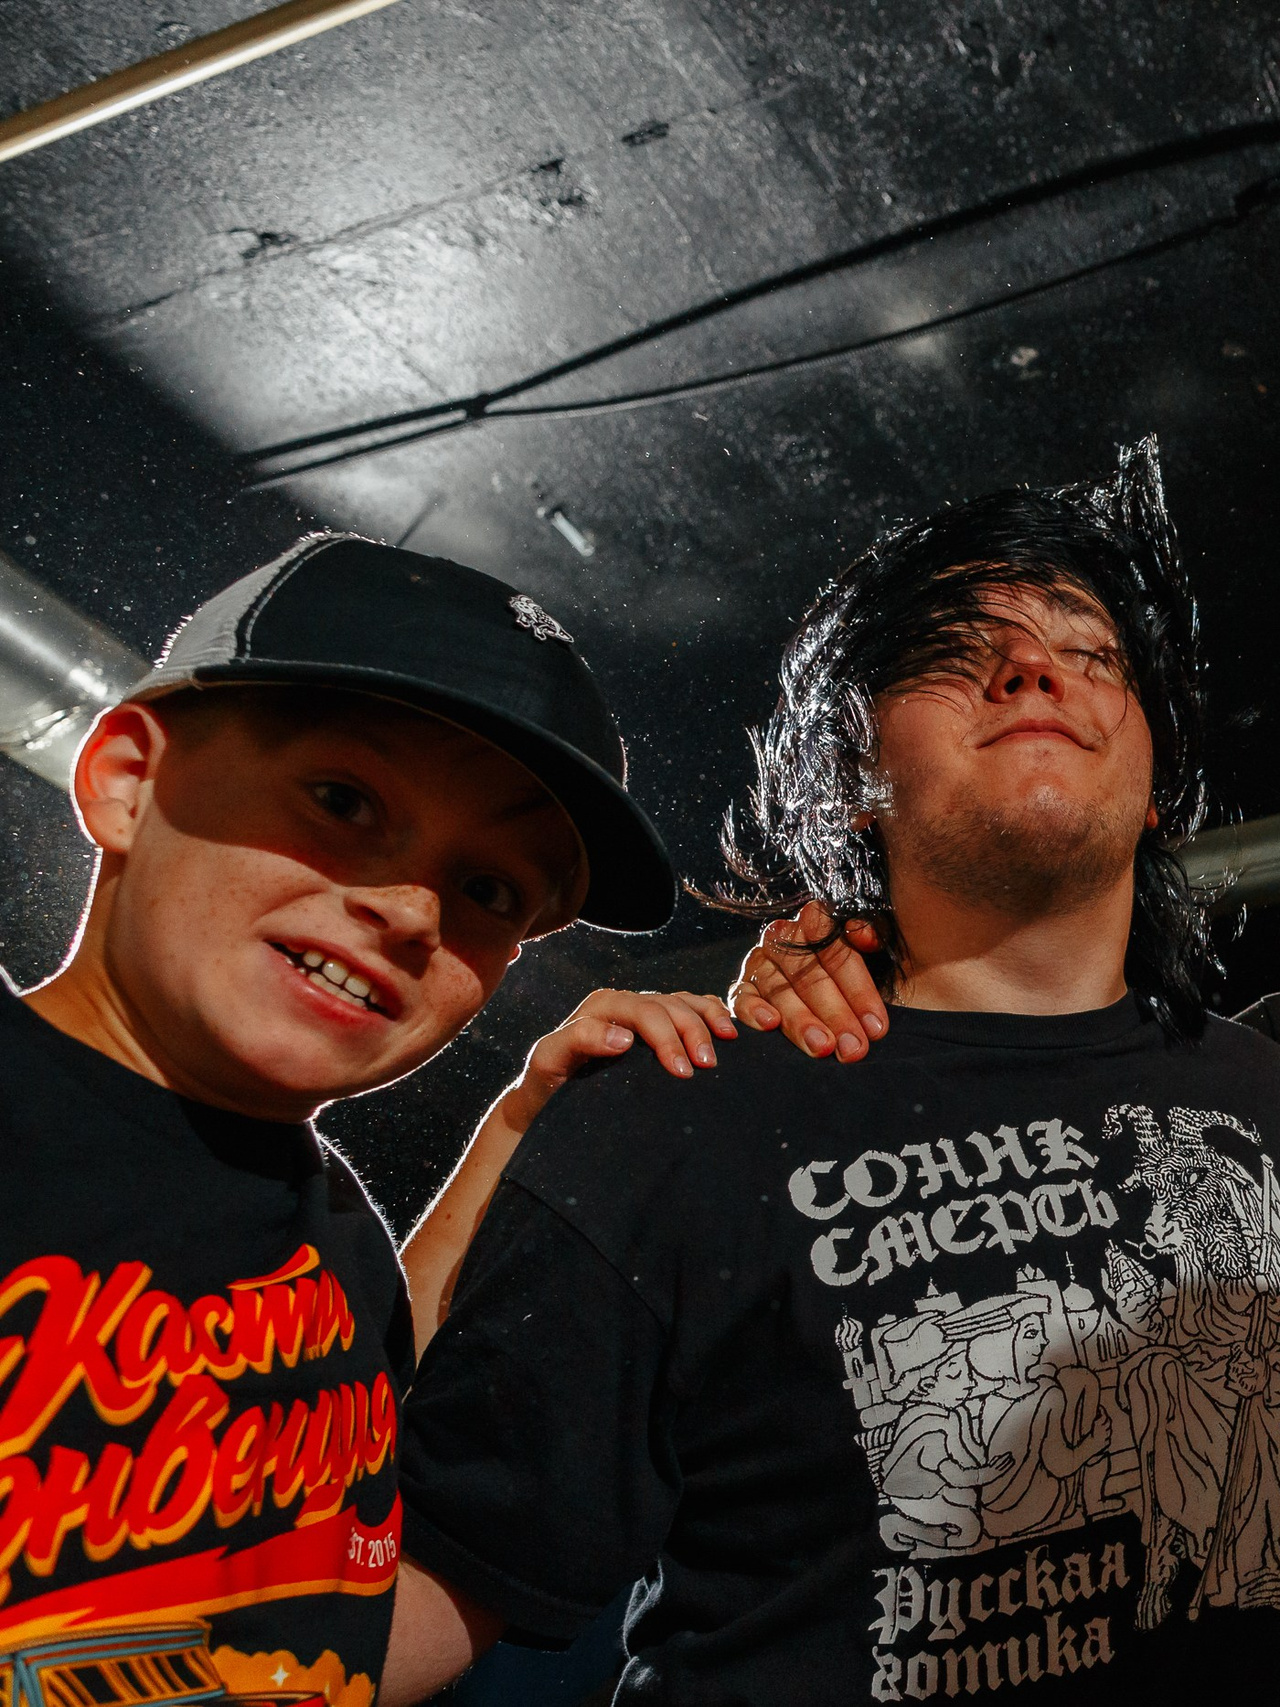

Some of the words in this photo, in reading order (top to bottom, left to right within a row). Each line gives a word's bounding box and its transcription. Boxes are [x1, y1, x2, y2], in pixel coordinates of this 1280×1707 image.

[788, 1118, 1099, 1220] СОНИК
[811, 1179, 1119, 1286] СМЕРТЬ
[0, 1371, 397, 1600] онвенция
[368, 1531, 397, 1568] 2015
[868, 1541, 1130, 1645] Русская
[870, 1610, 1116, 1703] готика
